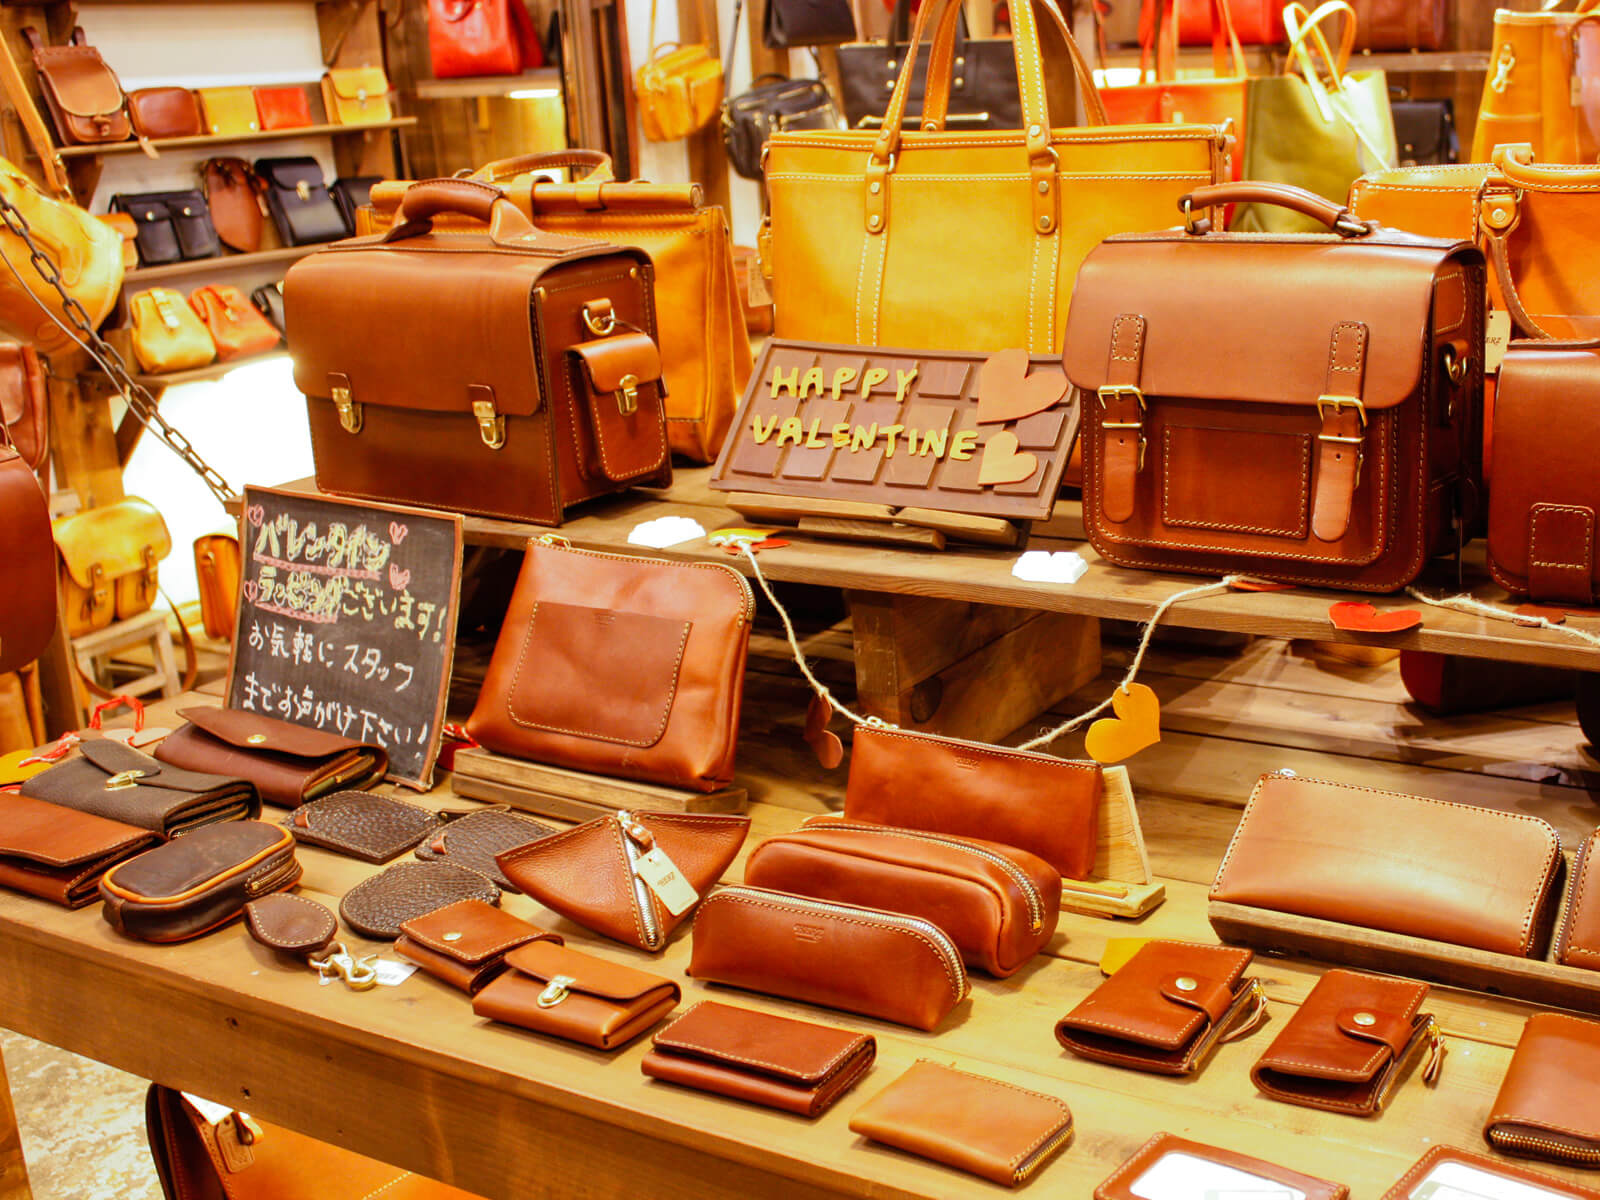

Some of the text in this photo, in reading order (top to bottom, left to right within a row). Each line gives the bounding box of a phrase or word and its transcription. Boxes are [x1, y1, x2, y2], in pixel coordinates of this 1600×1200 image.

[770, 366, 918, 402] HAPPY
[753, 414, 979, 461] VALENTINE
[254, 513, 391, 570] バレンタイン
